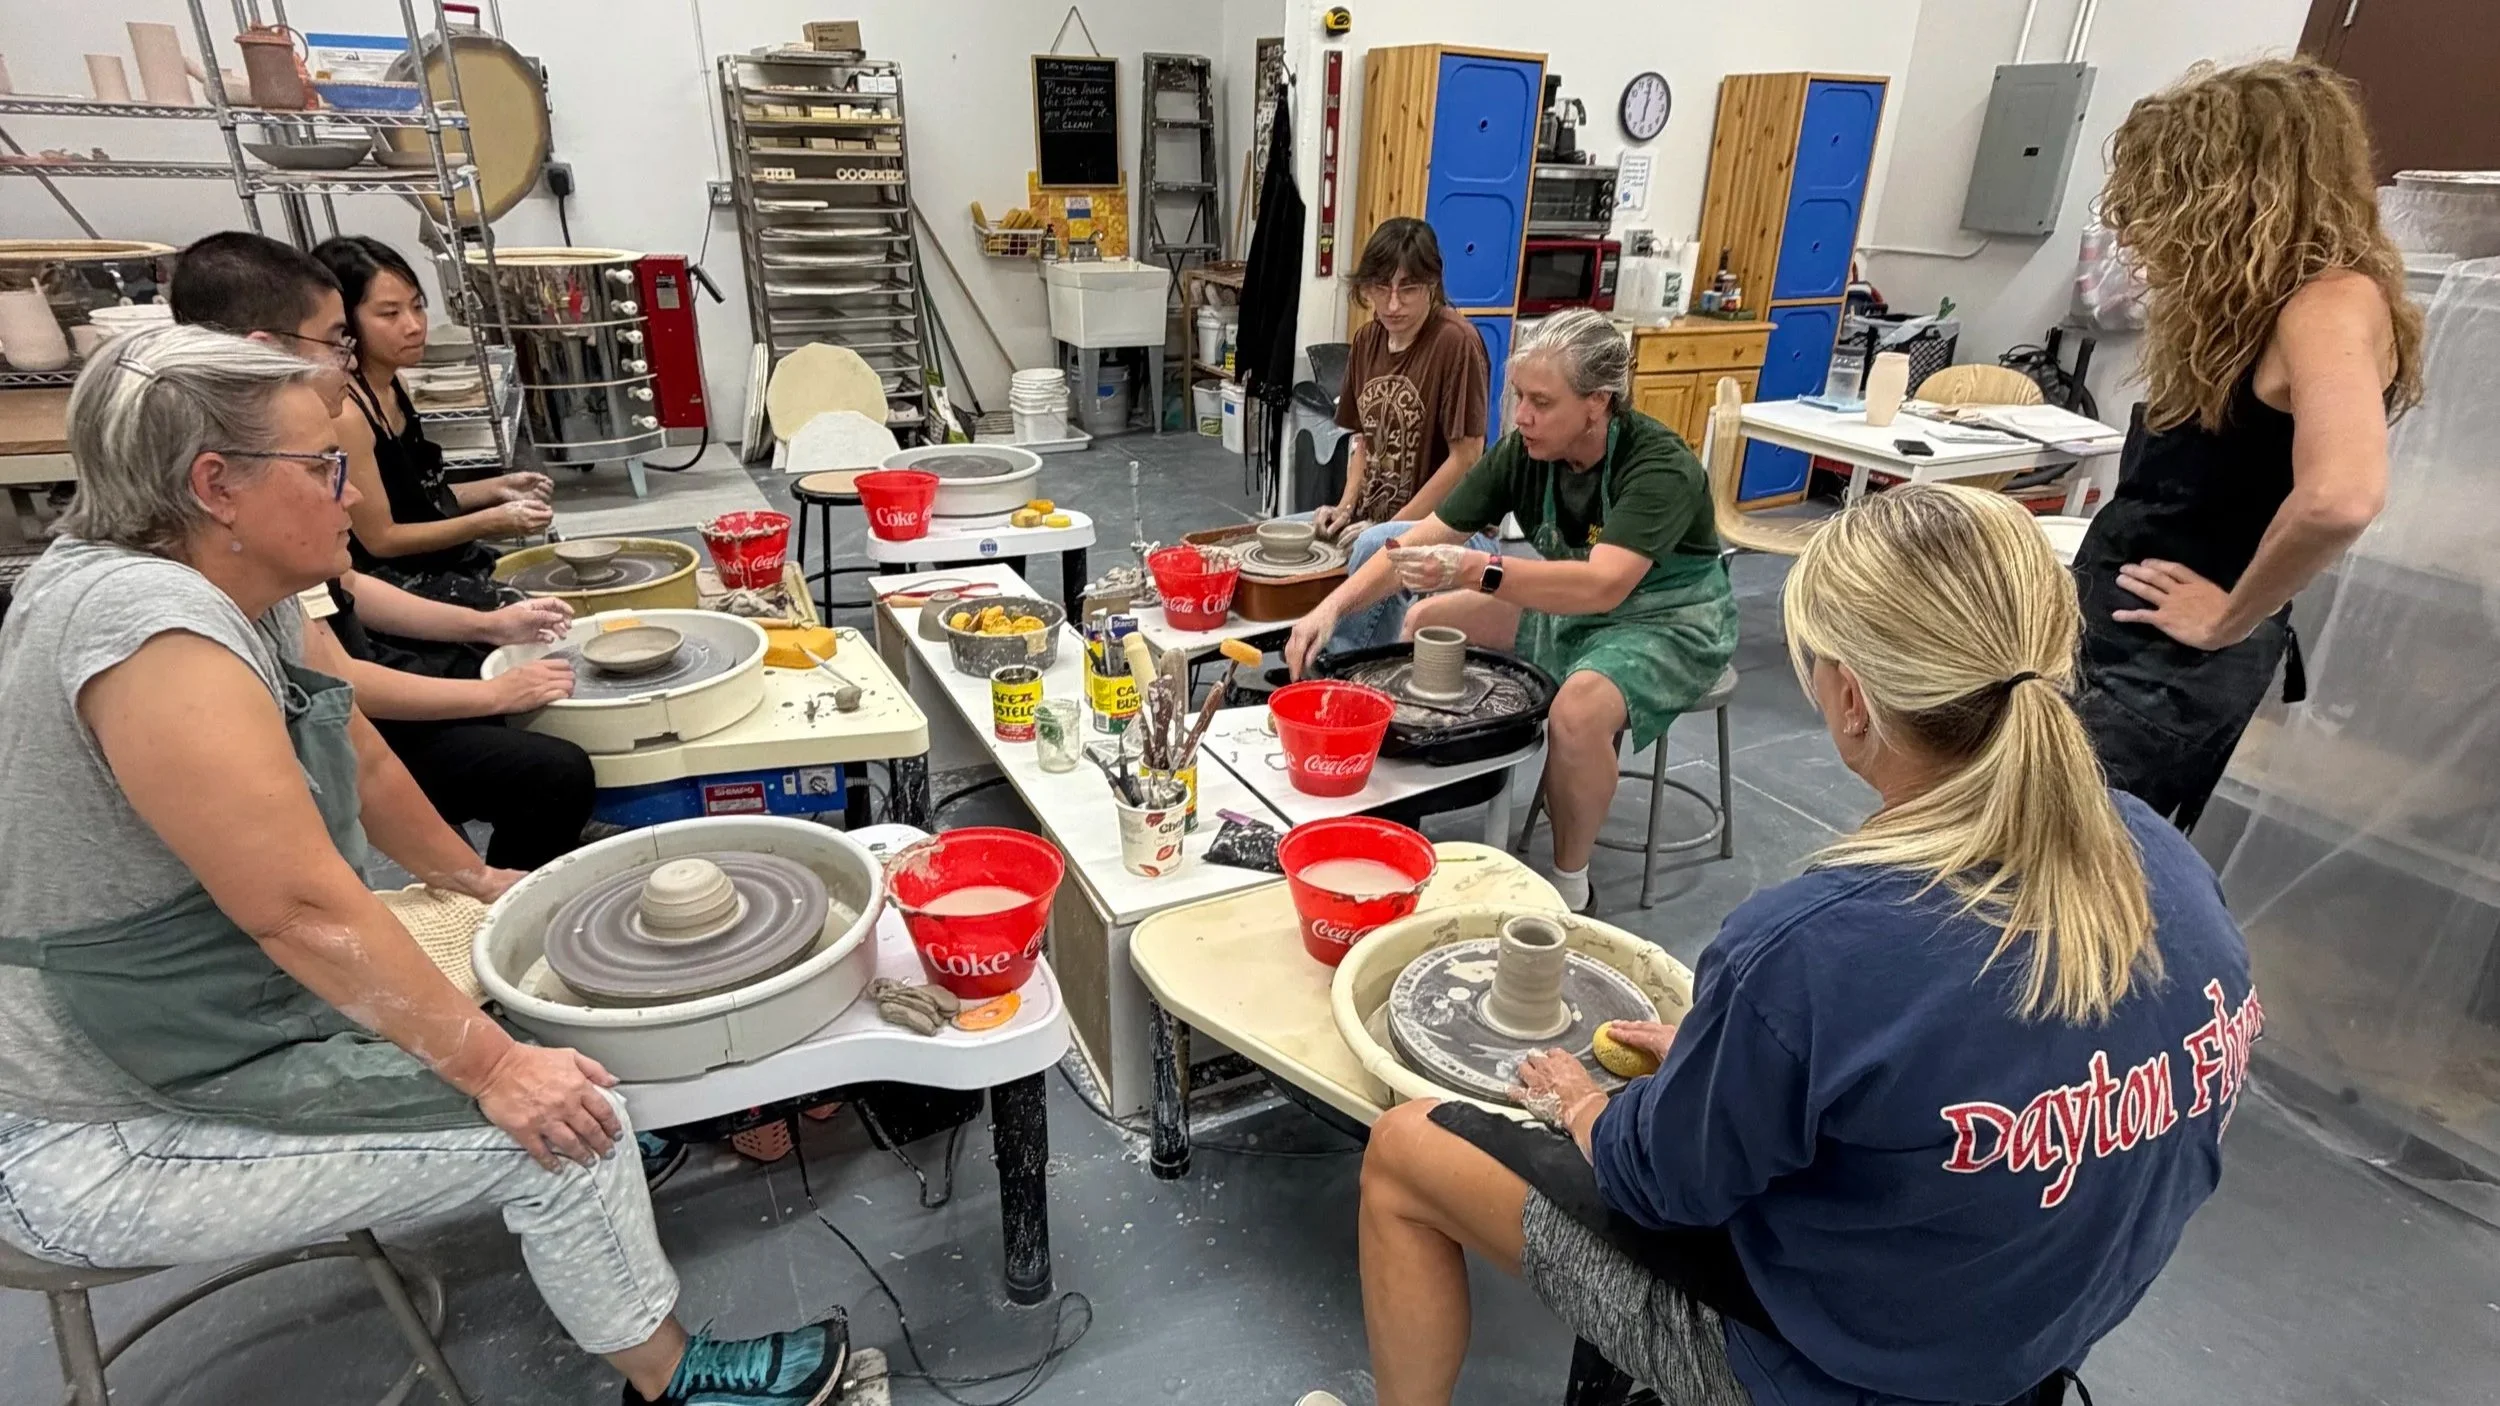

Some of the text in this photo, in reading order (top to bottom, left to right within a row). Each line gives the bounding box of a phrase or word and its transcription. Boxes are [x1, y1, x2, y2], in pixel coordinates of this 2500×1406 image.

[1044, 79, 1078, 95] Please
[1043, 95, 1060, 108] the
[1063, 95, 1090, 107] studio
[1361, 380, 1402, 409] NNY
[876, 507, 918, 527] Coke
[1202, 593, 1233, 616] Cok
[994, 691, 1016, 704] AFE
[1116, 685, 1138, 697] CA
[714, 786, 755, 797] SHIMPO
[1311, 918, 1380, 946] Coca-C
[925, 942, 1011, 977] Coke
[1940, 1050, 2179, 1209] Dayton
